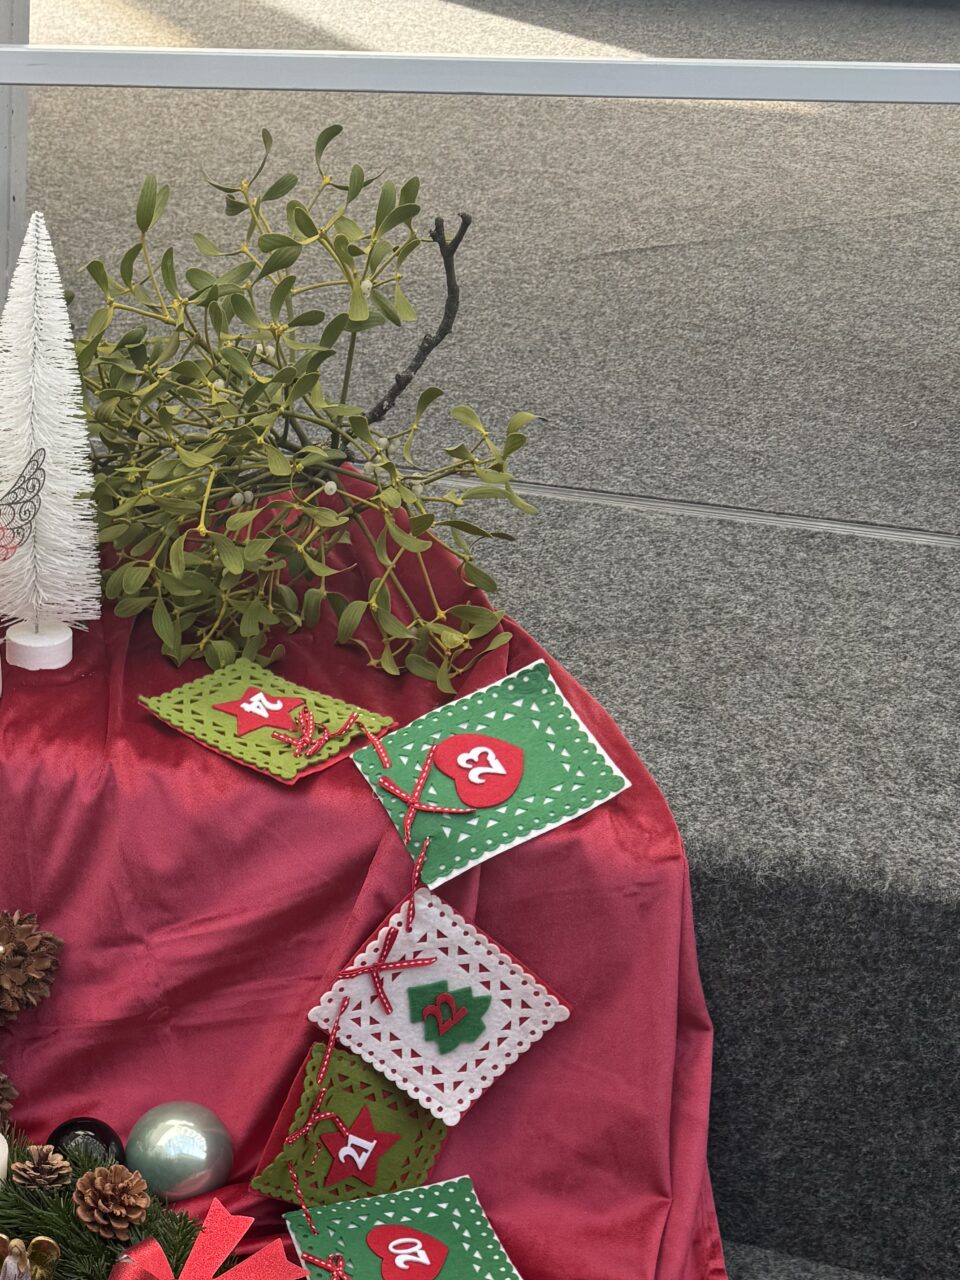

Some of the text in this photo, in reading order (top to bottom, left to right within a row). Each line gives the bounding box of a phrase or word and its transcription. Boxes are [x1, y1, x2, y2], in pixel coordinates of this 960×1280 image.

[239, 691, 283, 719] 24
[456, 746, 507, 783] 23
[421, 991, 469, 1037] 22
[337, 1134, 377, 1171] 21
[387, 1237, 431, 1270] 20
